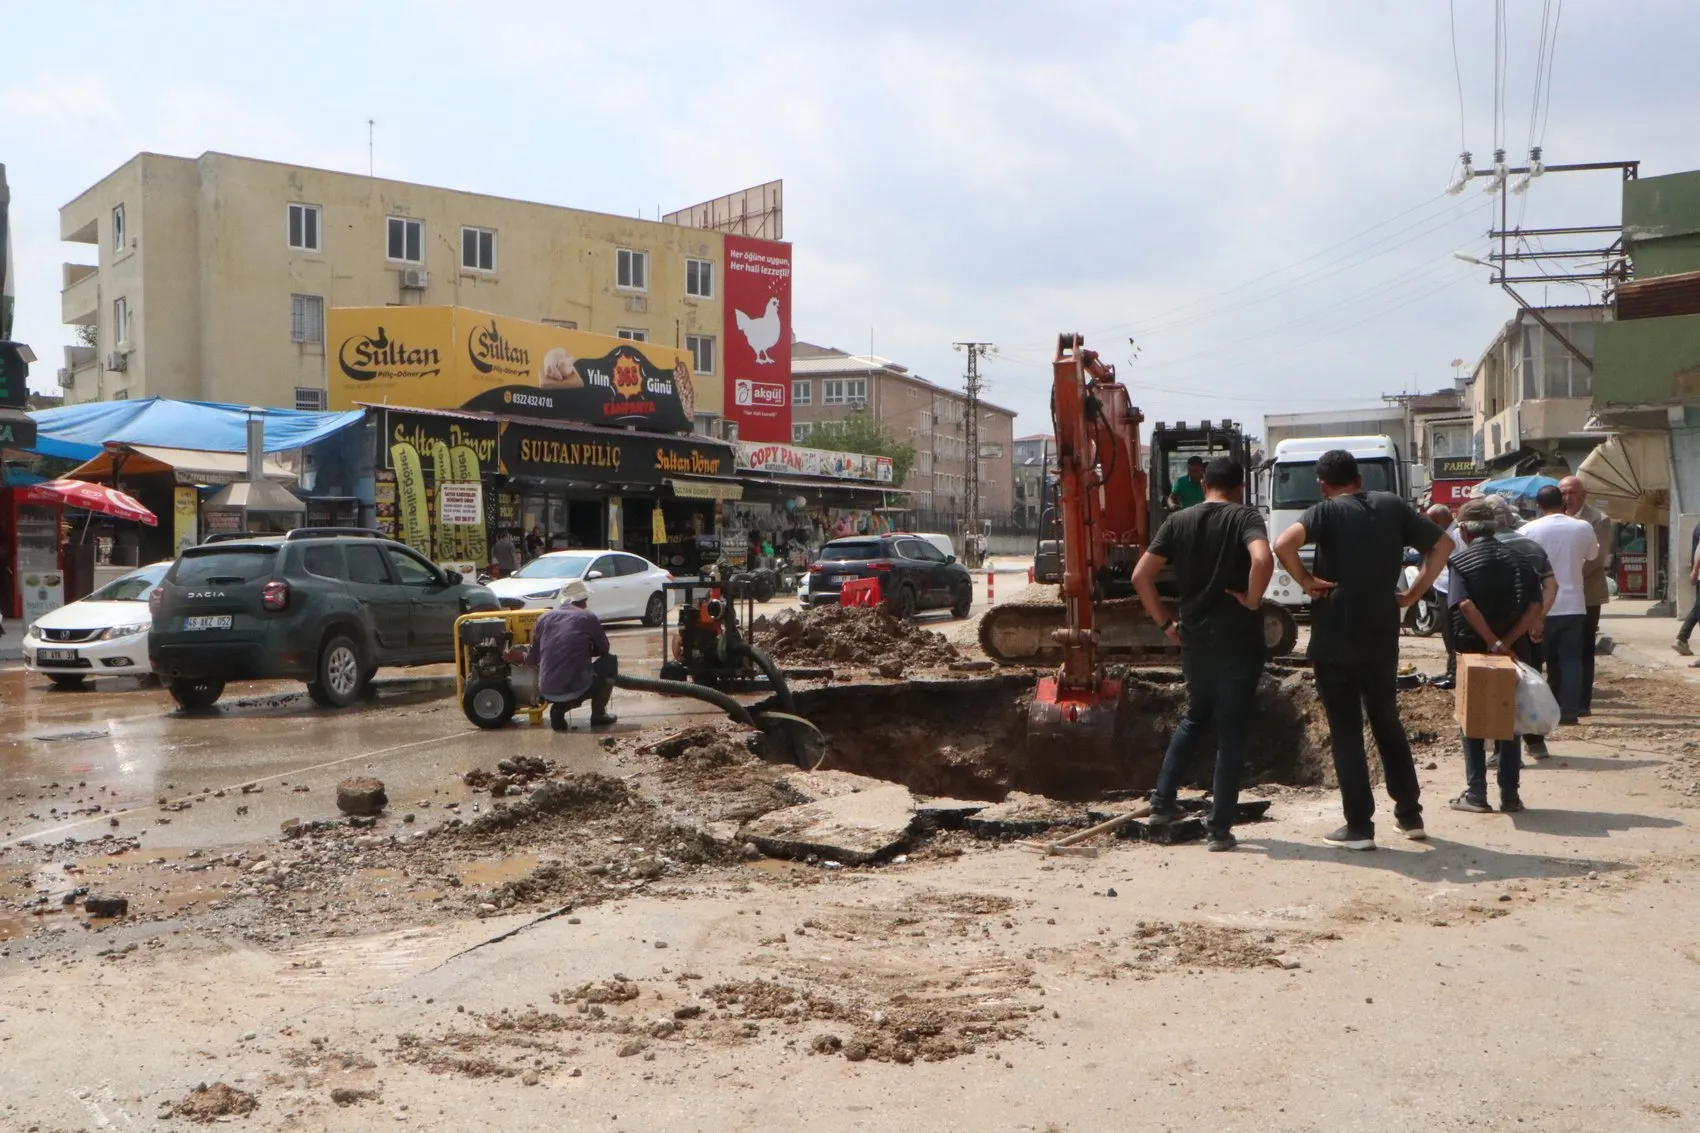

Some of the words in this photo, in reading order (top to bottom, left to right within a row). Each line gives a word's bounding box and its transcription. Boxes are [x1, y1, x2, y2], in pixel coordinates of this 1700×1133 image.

[730, 249, 743, 258] Her
[730, 261, 744, 271] Her
[745, 262, 760, 273] hali
[352, 338, 441, 367] Sultan
[477, 330, 530, 365] Sultan
[587, 368, 610, 387] Yılın
[647, 377, 672, 395] Günü
[512, 393, 527, 405] 0322
[527, 395, 538, 406] 432
[538, 396, 546, 407] 47
[754, 387, 782, 401] akgül
[520, 438, 580, 465] SULTAN
[582, 440, 621, 473] PİLİÇ
[654, 448, 690, 472] Sultan
[750, 446, 779, 469] COPY
